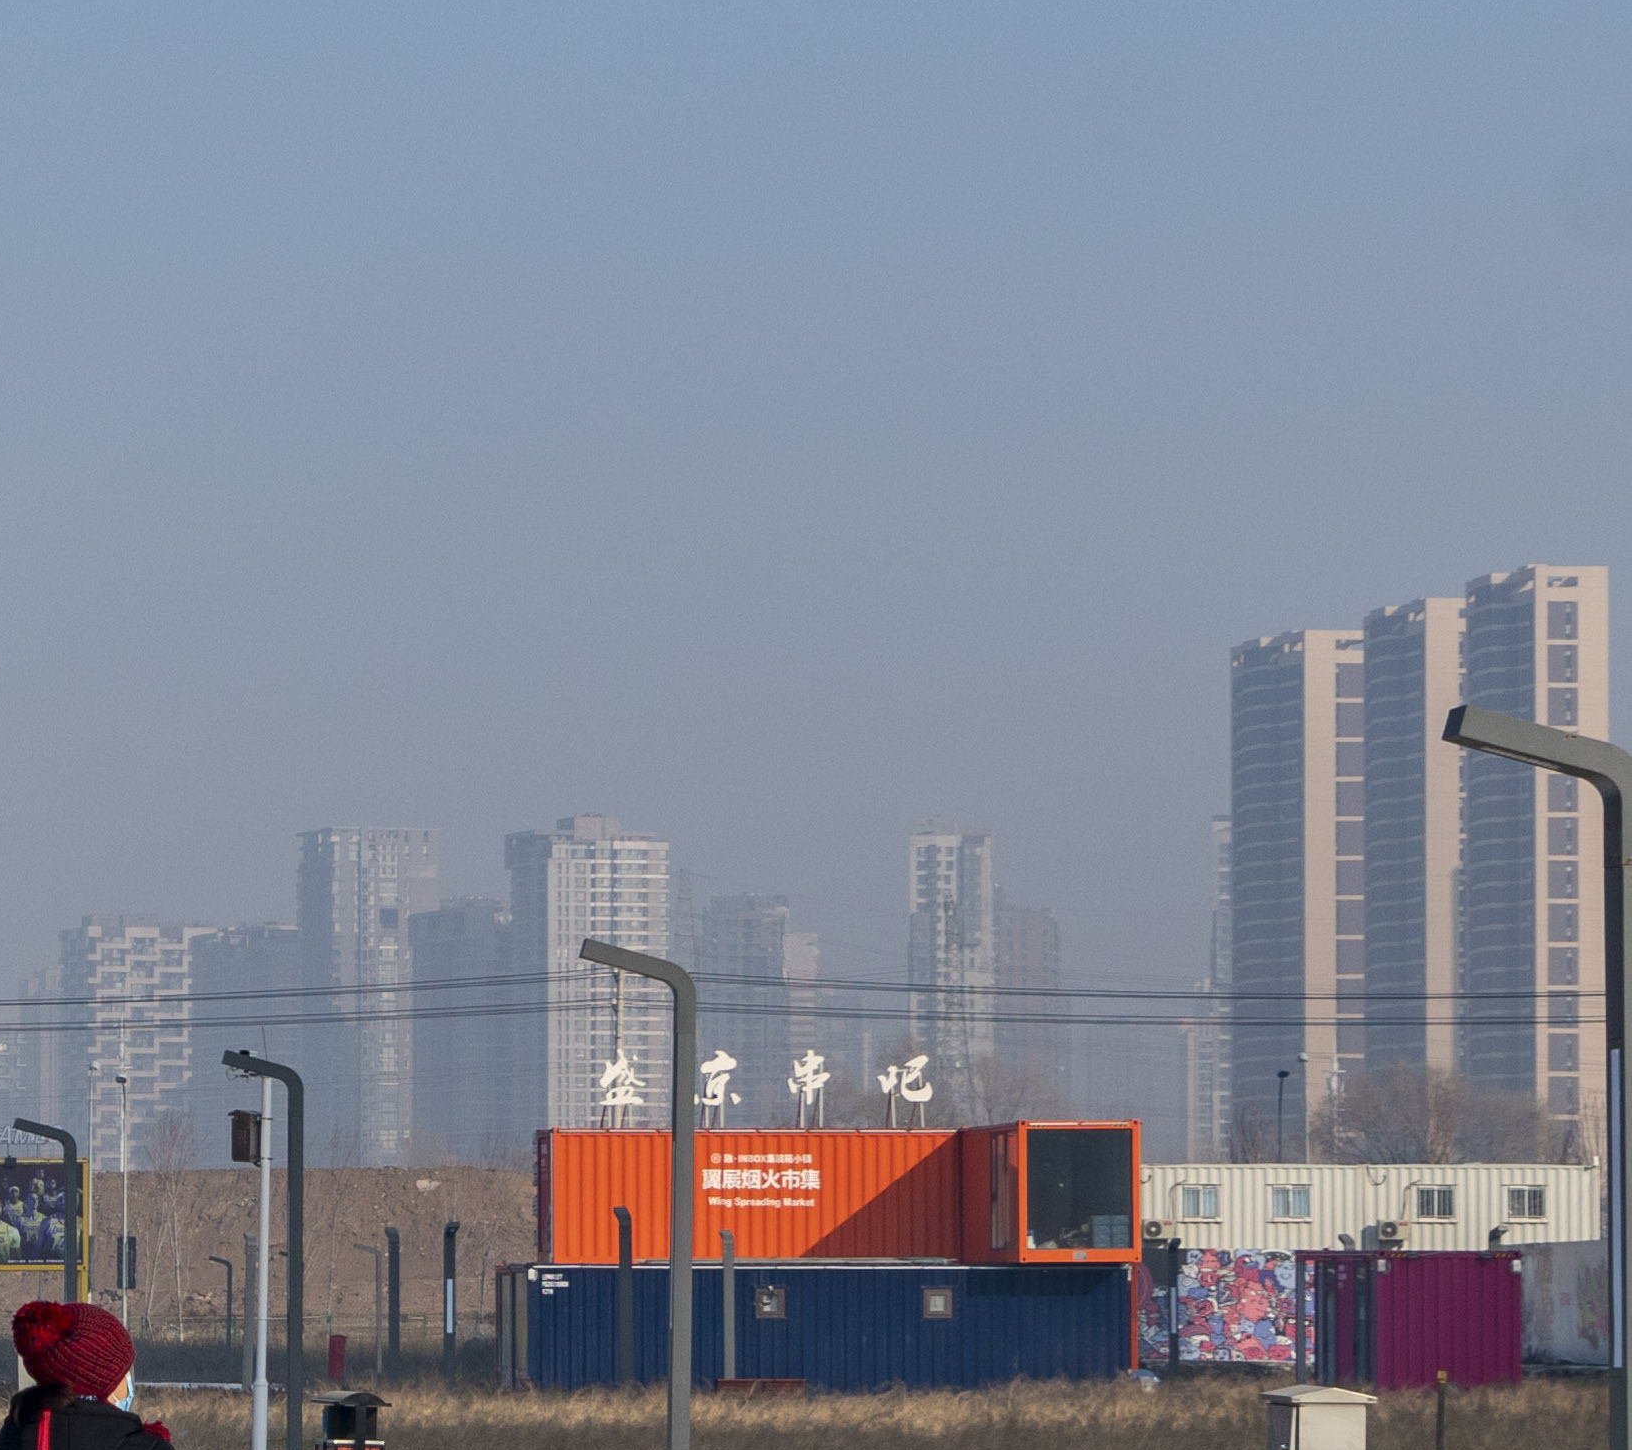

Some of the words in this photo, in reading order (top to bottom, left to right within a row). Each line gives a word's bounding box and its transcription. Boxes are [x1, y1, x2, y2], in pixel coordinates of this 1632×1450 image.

[702, 1169, 821, 1190] 翼展烟火市集
[708, 1197, 732, 1207] Wing
[734, 1197, 781, 1208] Spreading
[783, 1198, 815, 1207] Market
